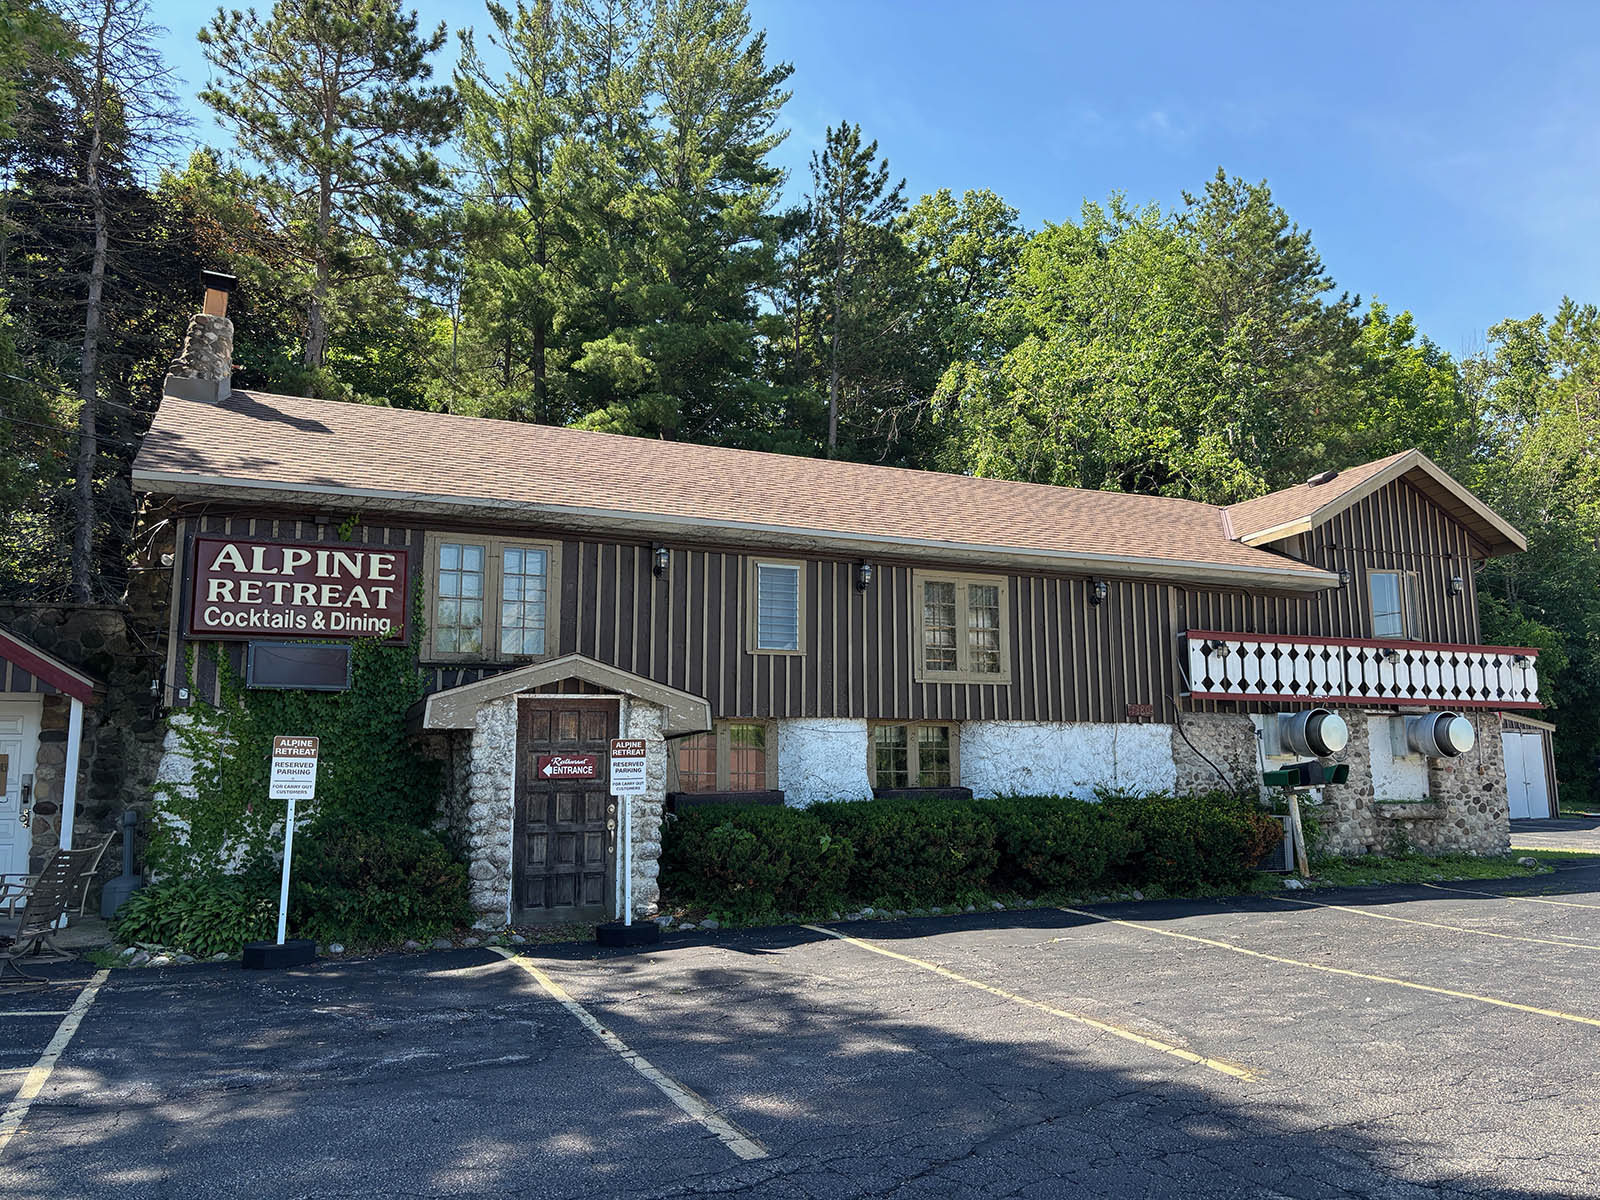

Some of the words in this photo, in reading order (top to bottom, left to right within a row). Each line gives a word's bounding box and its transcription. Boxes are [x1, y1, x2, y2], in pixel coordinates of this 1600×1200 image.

[209, 543, 396, 581] ALPINE
[206, 578, 394, 609] RETREAT
[203, 606, 307, 629] Cocktails
[311, 610, 326, 630] &
[330, 611, 391, 635] Dining
[275, 747, 316, 755] RETREAT
[280, 739, 313, 747] ALPINE
[553, 766, 593, 774] ENTRANCE
